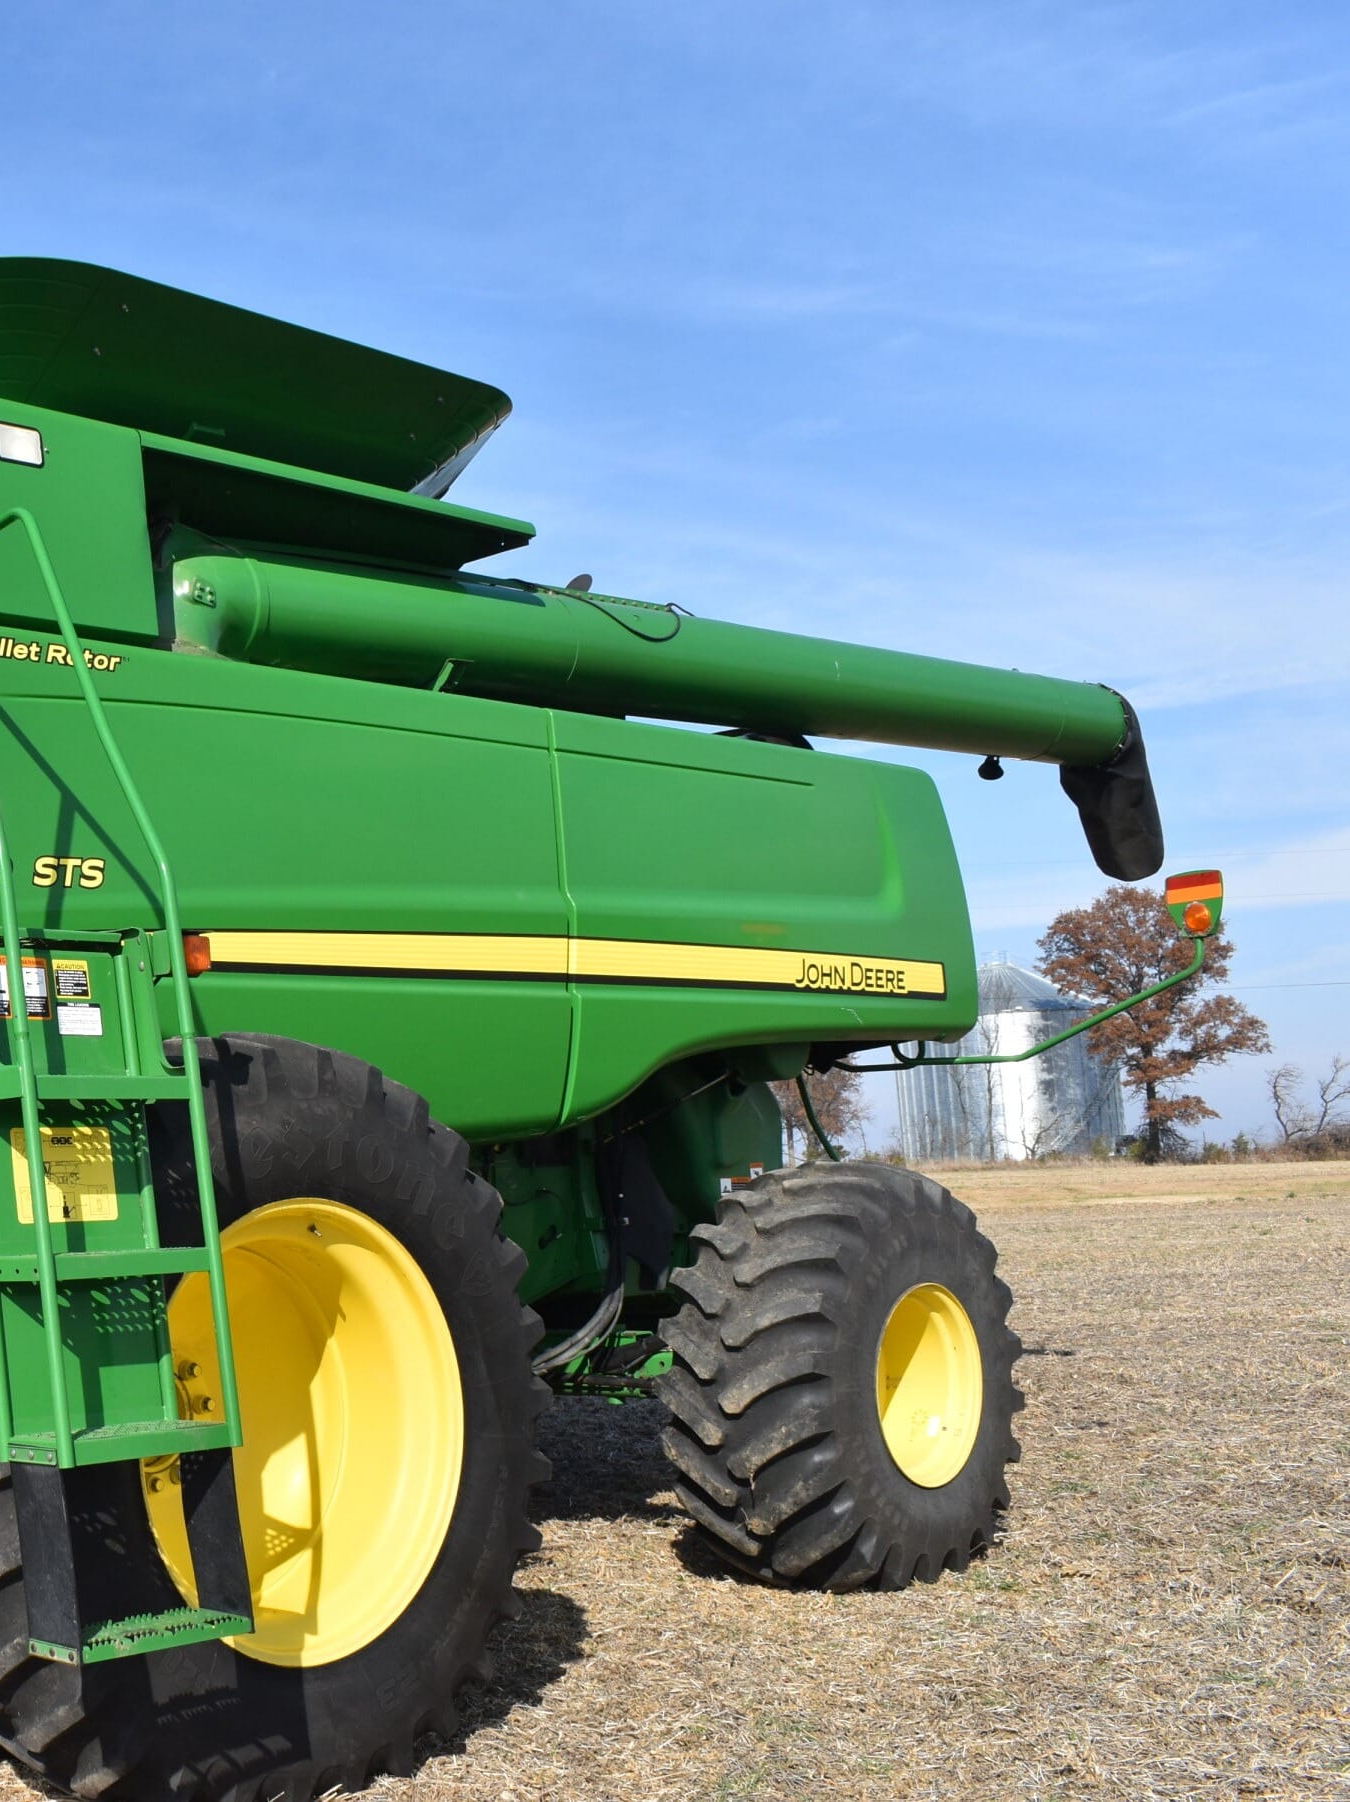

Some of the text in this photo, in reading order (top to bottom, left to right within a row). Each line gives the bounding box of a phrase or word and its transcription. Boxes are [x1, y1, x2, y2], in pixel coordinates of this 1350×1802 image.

[32, 854, 106, 890] STS
[795, 958, 906, 990] JOHN DEERE
